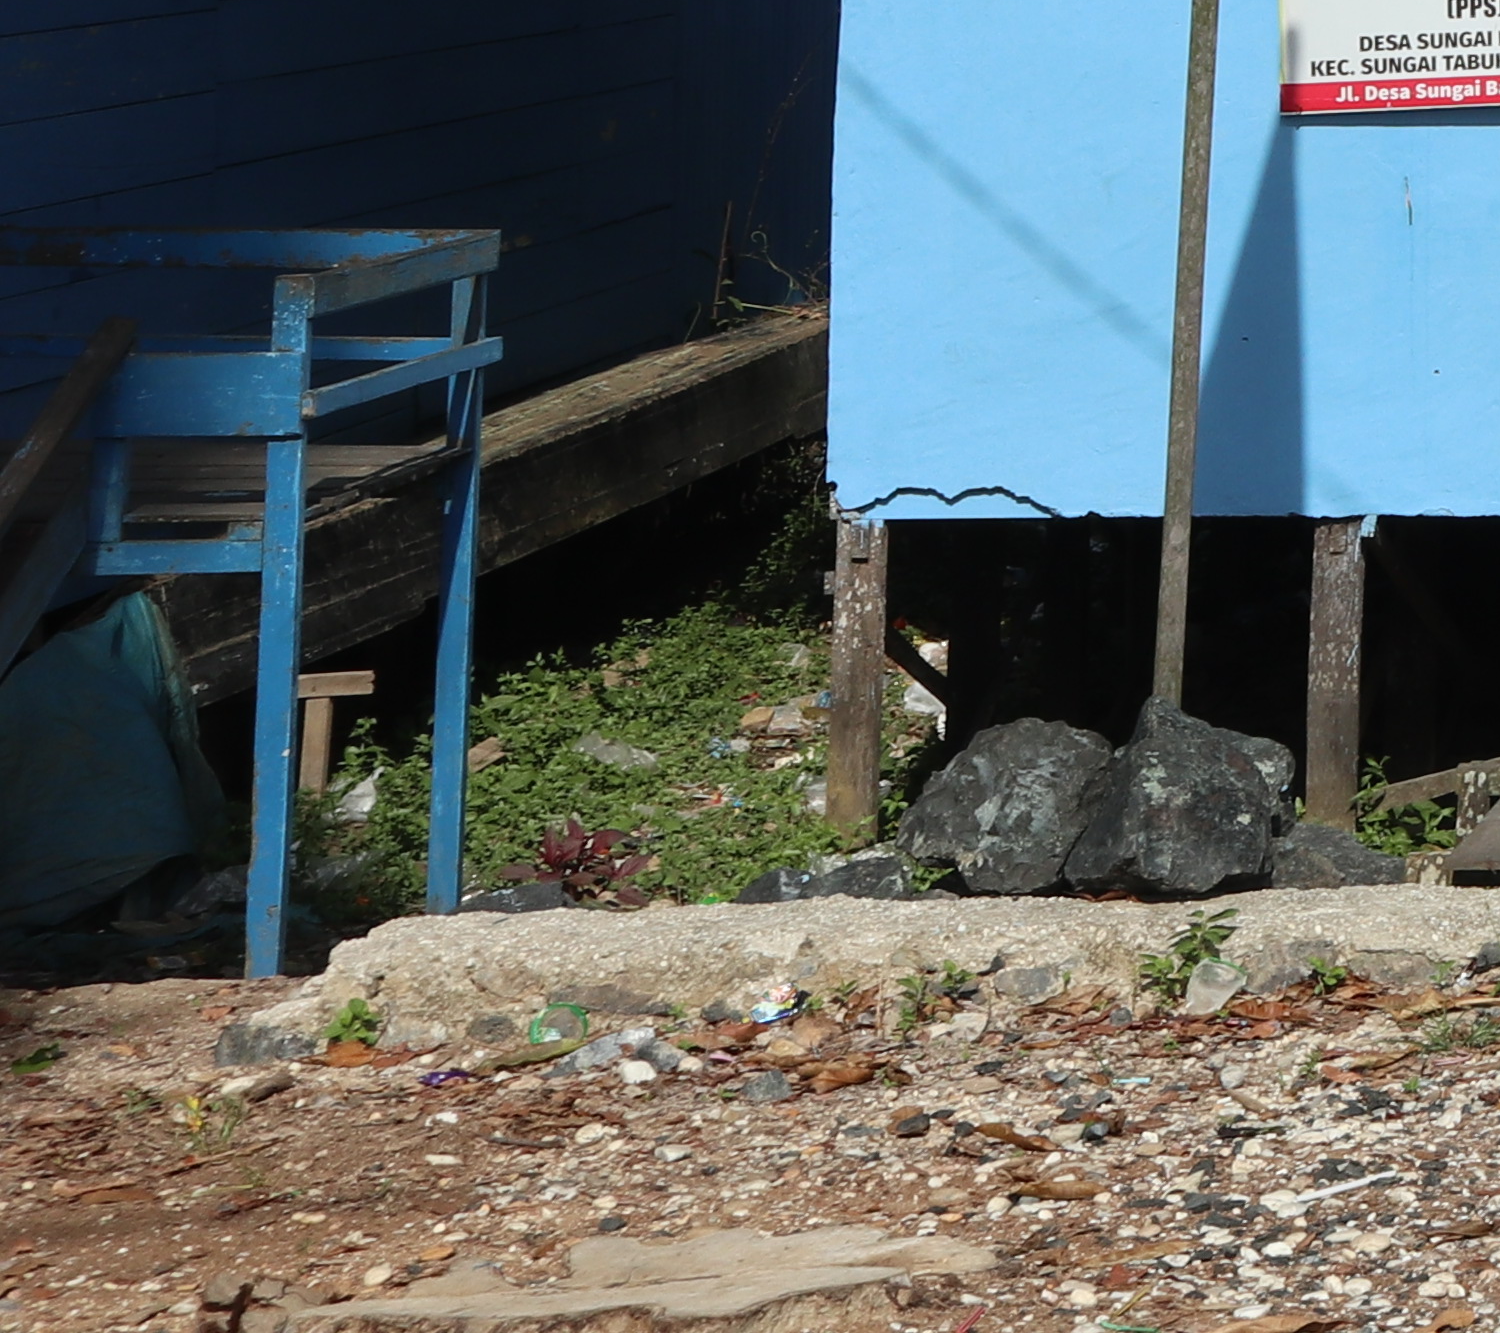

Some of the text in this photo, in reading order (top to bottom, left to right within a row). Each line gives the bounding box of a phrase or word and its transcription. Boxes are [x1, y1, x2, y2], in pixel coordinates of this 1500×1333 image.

[1360, 34, 1411, 53] DESA
[1418, 31, 1492, 50] SUNGAI
[1311, 59, 1355, 77] KEC.
[1361, 56, 1436, 75] SUNGAI
[1336, 86, 1359, 103] Jl.
[1365, 83, 1410, 101] Desa
[1416, 78, 1480, 103] Sungai
